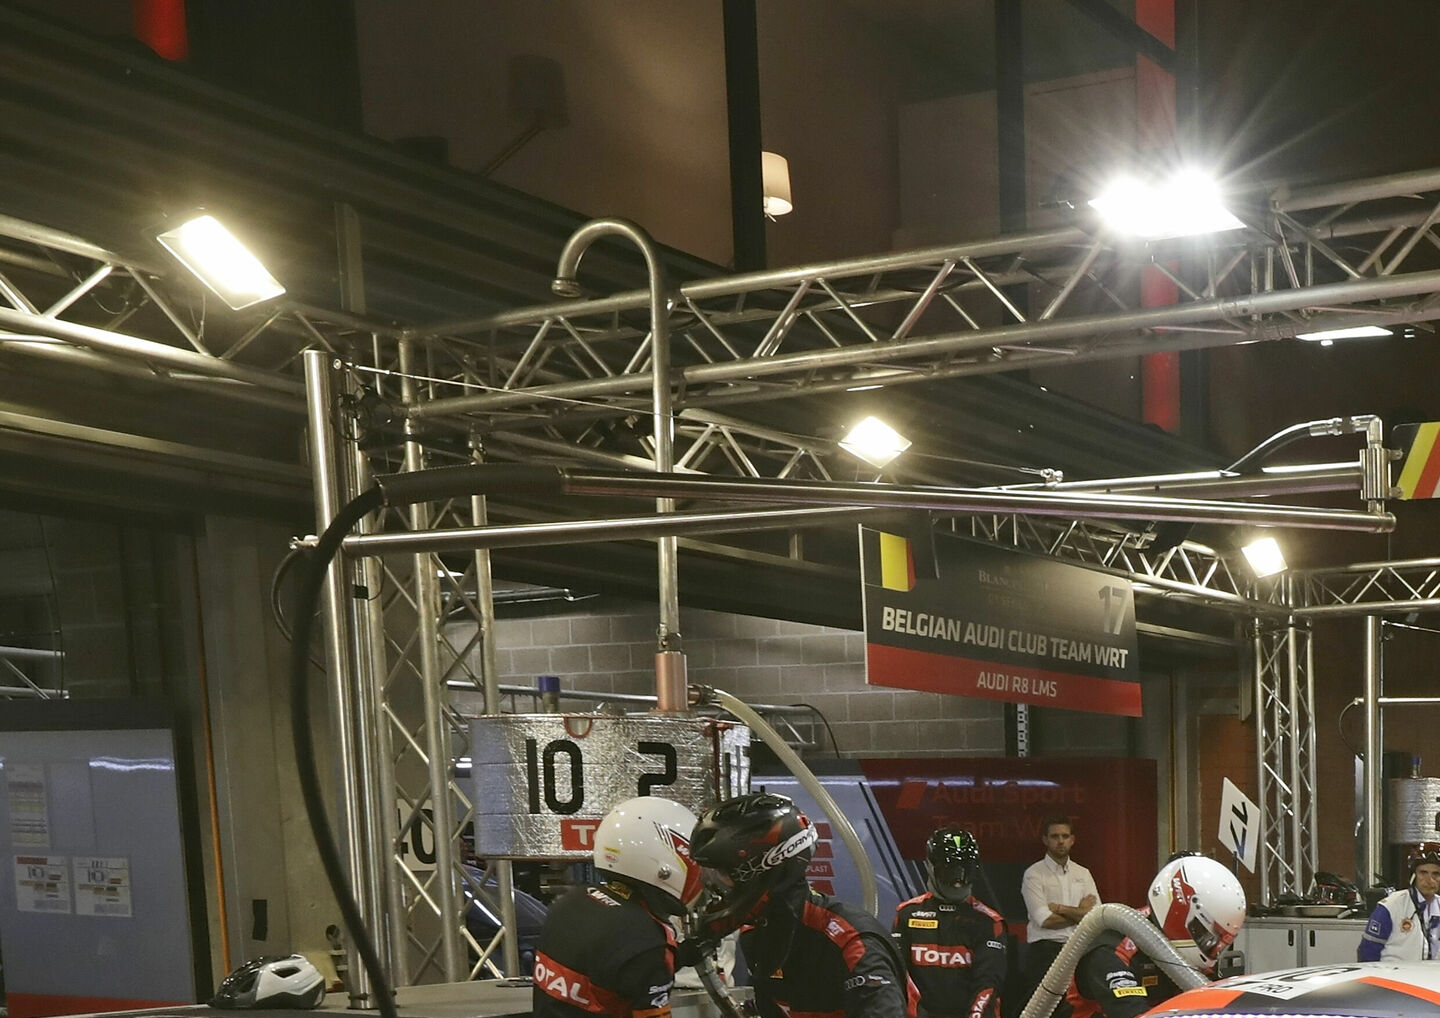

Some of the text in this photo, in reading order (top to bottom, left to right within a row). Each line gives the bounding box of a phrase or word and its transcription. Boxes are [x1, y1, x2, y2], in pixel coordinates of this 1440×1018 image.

[1098, 585, 1131, 636] 17
[881, 606, 1129, 669] BELGIAN AUDI CLUB TEAM WRT
[976, 671, 1058, 698] AUDI R8 LMS
[525, 738, 585, 815] 10
[535, 955, 590, 1005] OTAL
